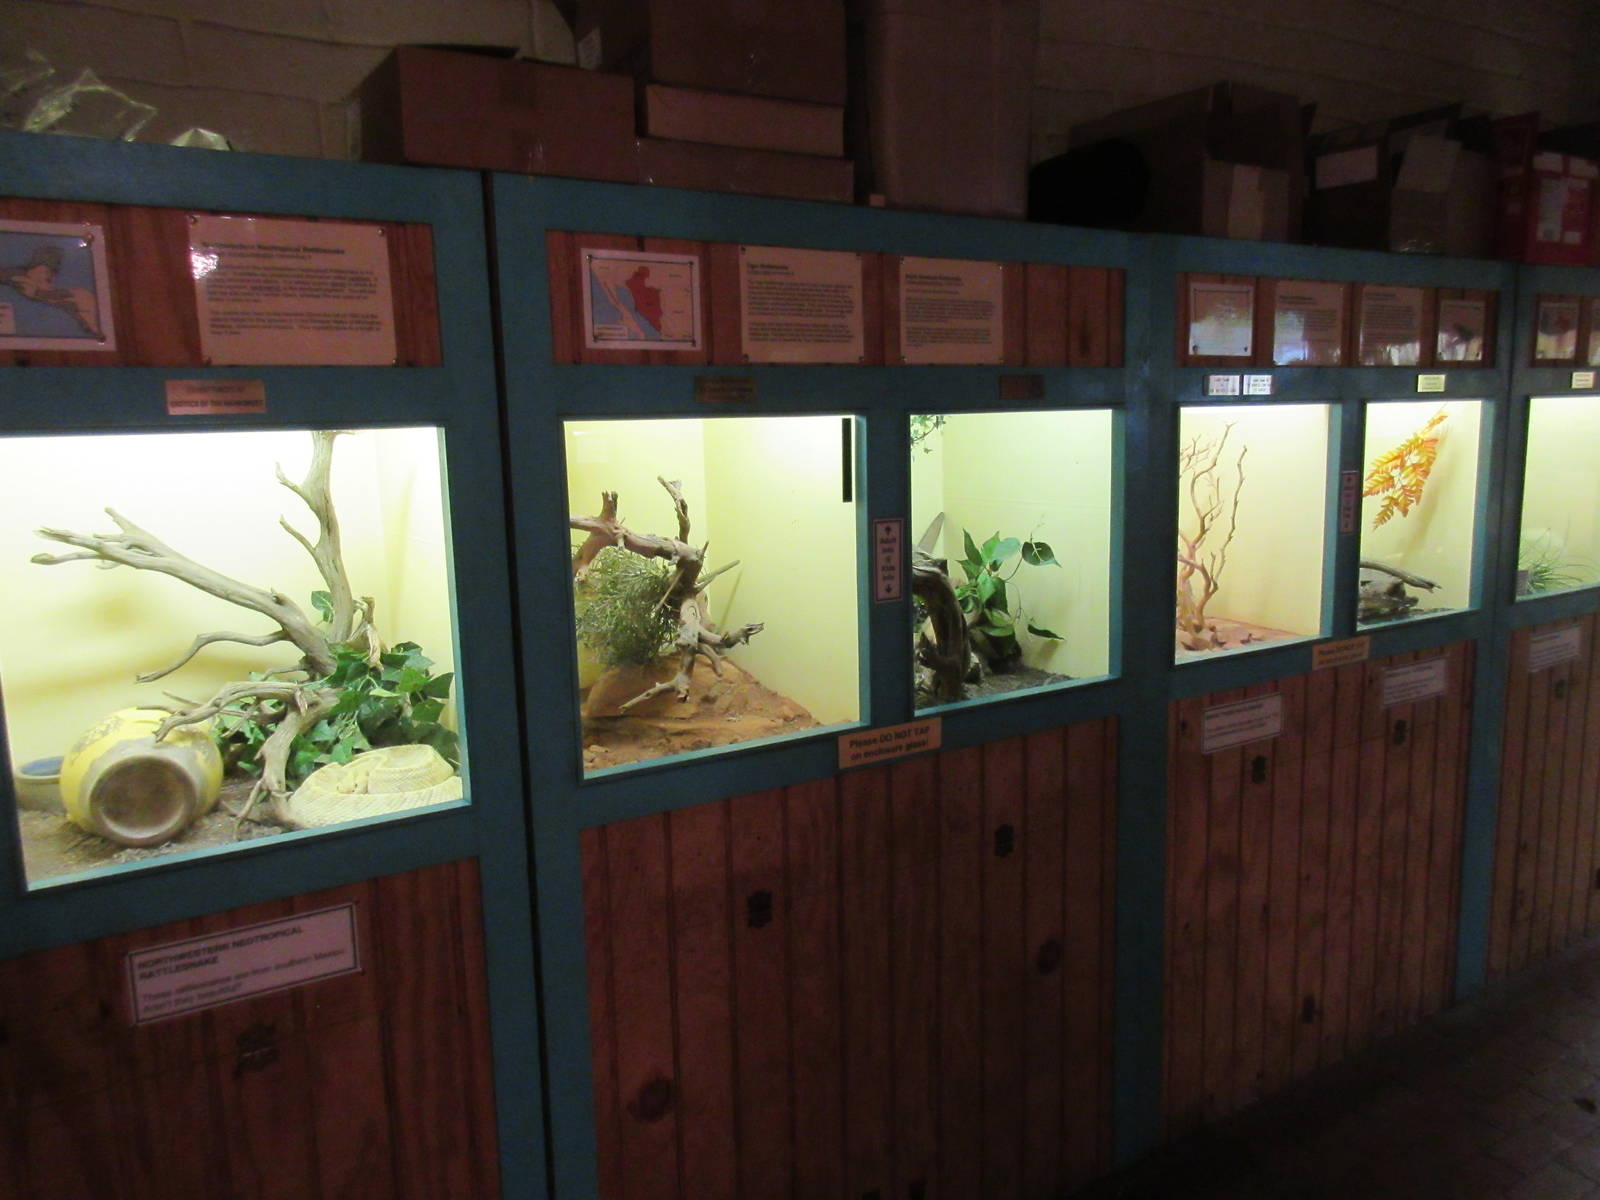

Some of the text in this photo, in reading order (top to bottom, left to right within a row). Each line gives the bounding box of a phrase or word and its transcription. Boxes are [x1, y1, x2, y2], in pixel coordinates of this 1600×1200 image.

[849, 725, 931, 749] Please DO NOT TAP
[137, 925, 303, 970] NORTHWESTERN NEOTROPICAL
[139, 955, 219, 980] RATTLESNAKE
